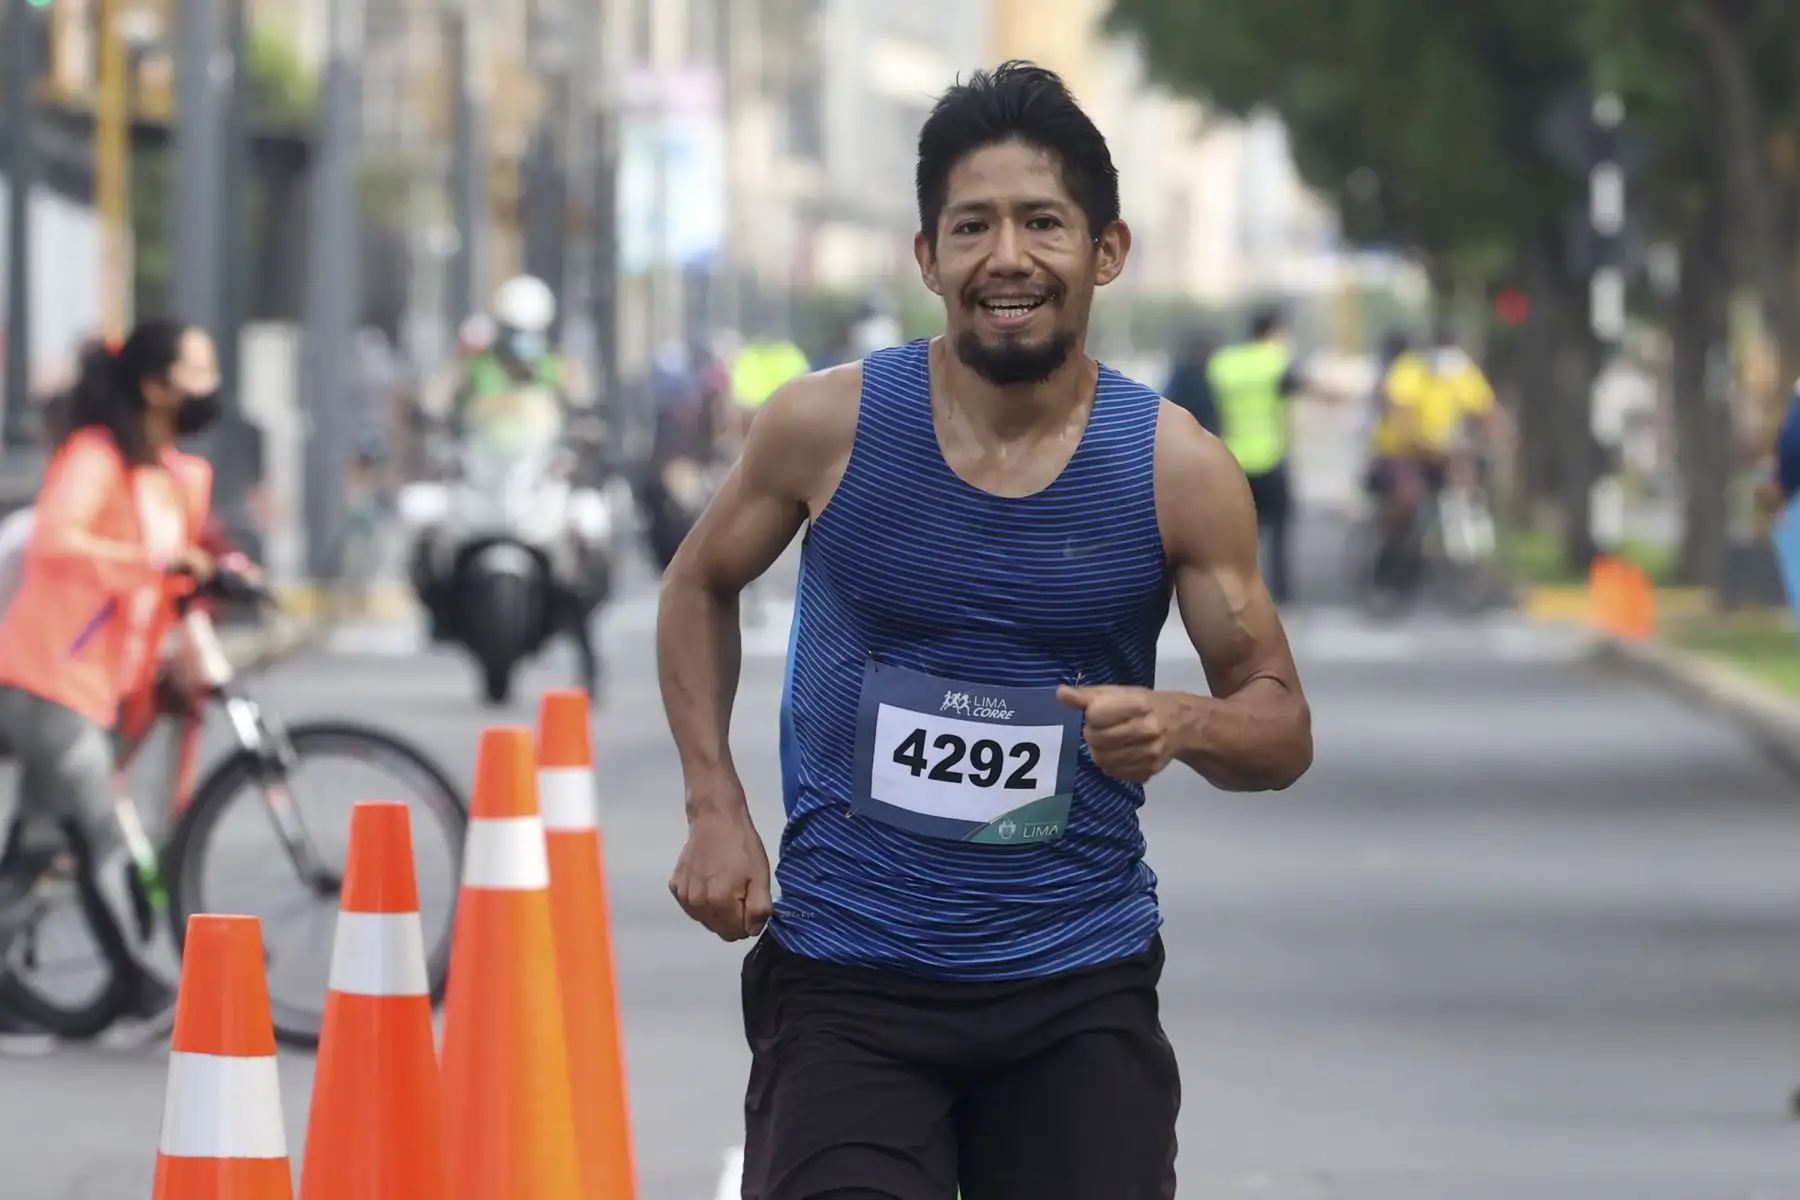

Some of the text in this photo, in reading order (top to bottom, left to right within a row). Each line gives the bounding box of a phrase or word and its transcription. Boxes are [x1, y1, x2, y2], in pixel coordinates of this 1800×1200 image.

[973, 696, 1007, 709] LIMA
[972, 707, 1015, 719] CORRE
[893, 728, 1041, 789] 4292
[1023, 825, 1059, 838] LIMA
